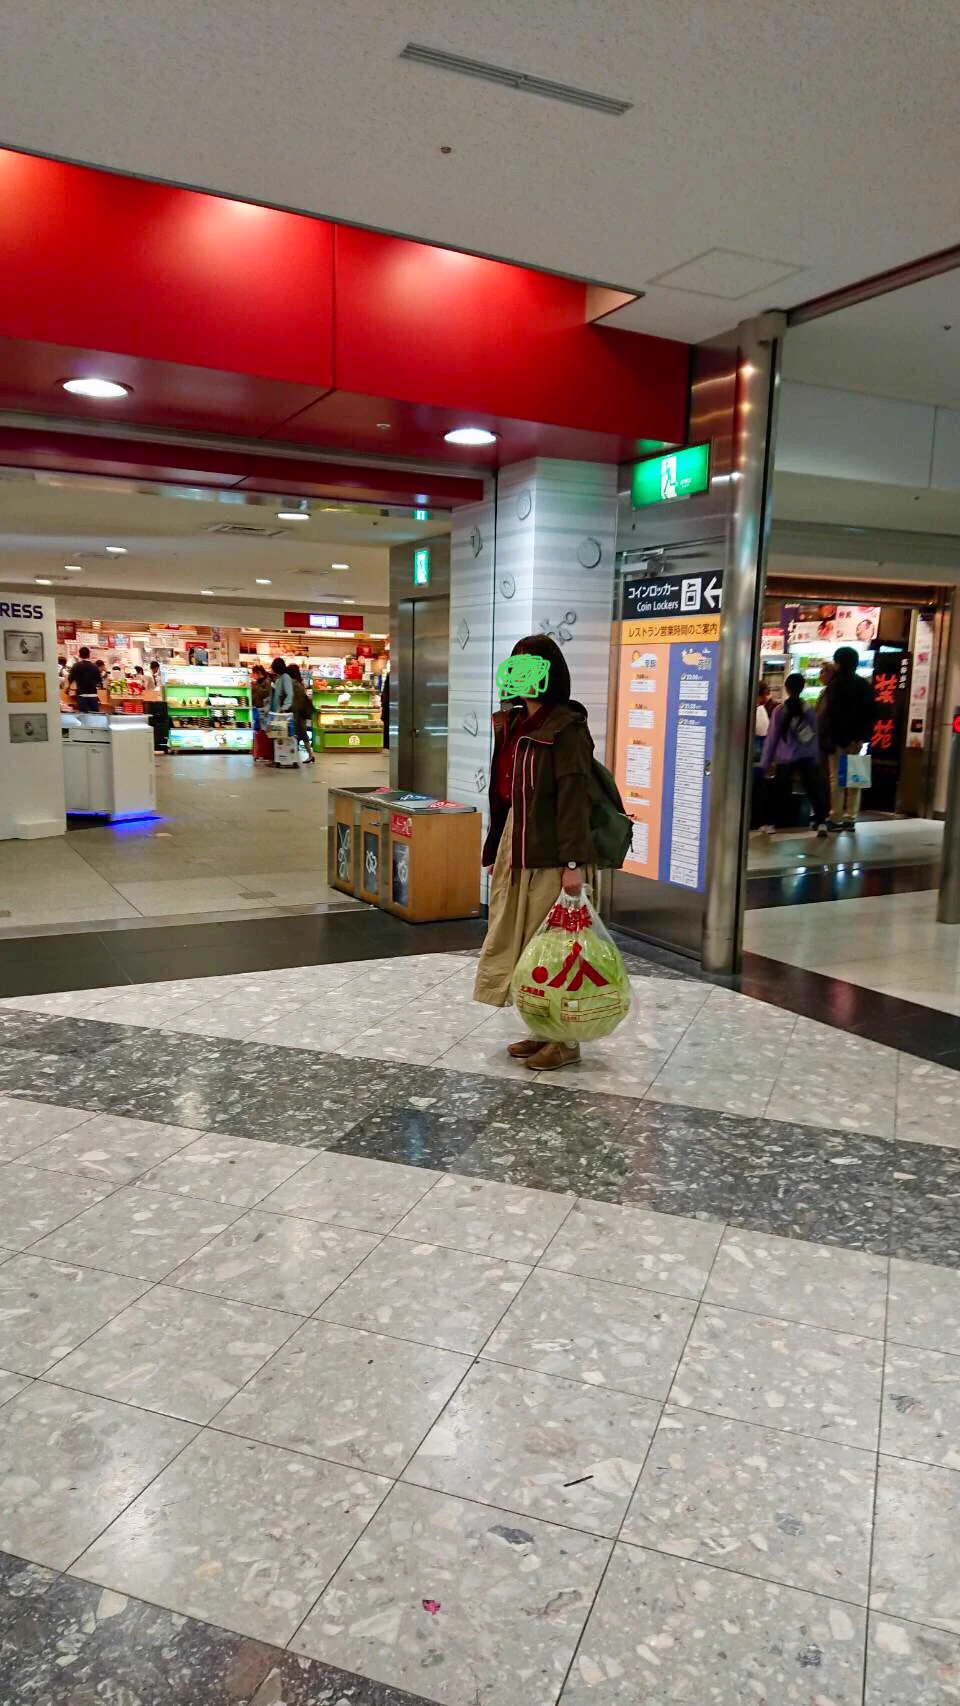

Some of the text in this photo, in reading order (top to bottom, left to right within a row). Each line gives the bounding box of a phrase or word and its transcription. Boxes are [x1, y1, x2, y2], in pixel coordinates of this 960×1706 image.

[628, 583, 679, 598] コインロッカー
[637, 600, 679, 612] Coin Lockers
[628, 623, 718, 638] レストラン営業時間のご案内
